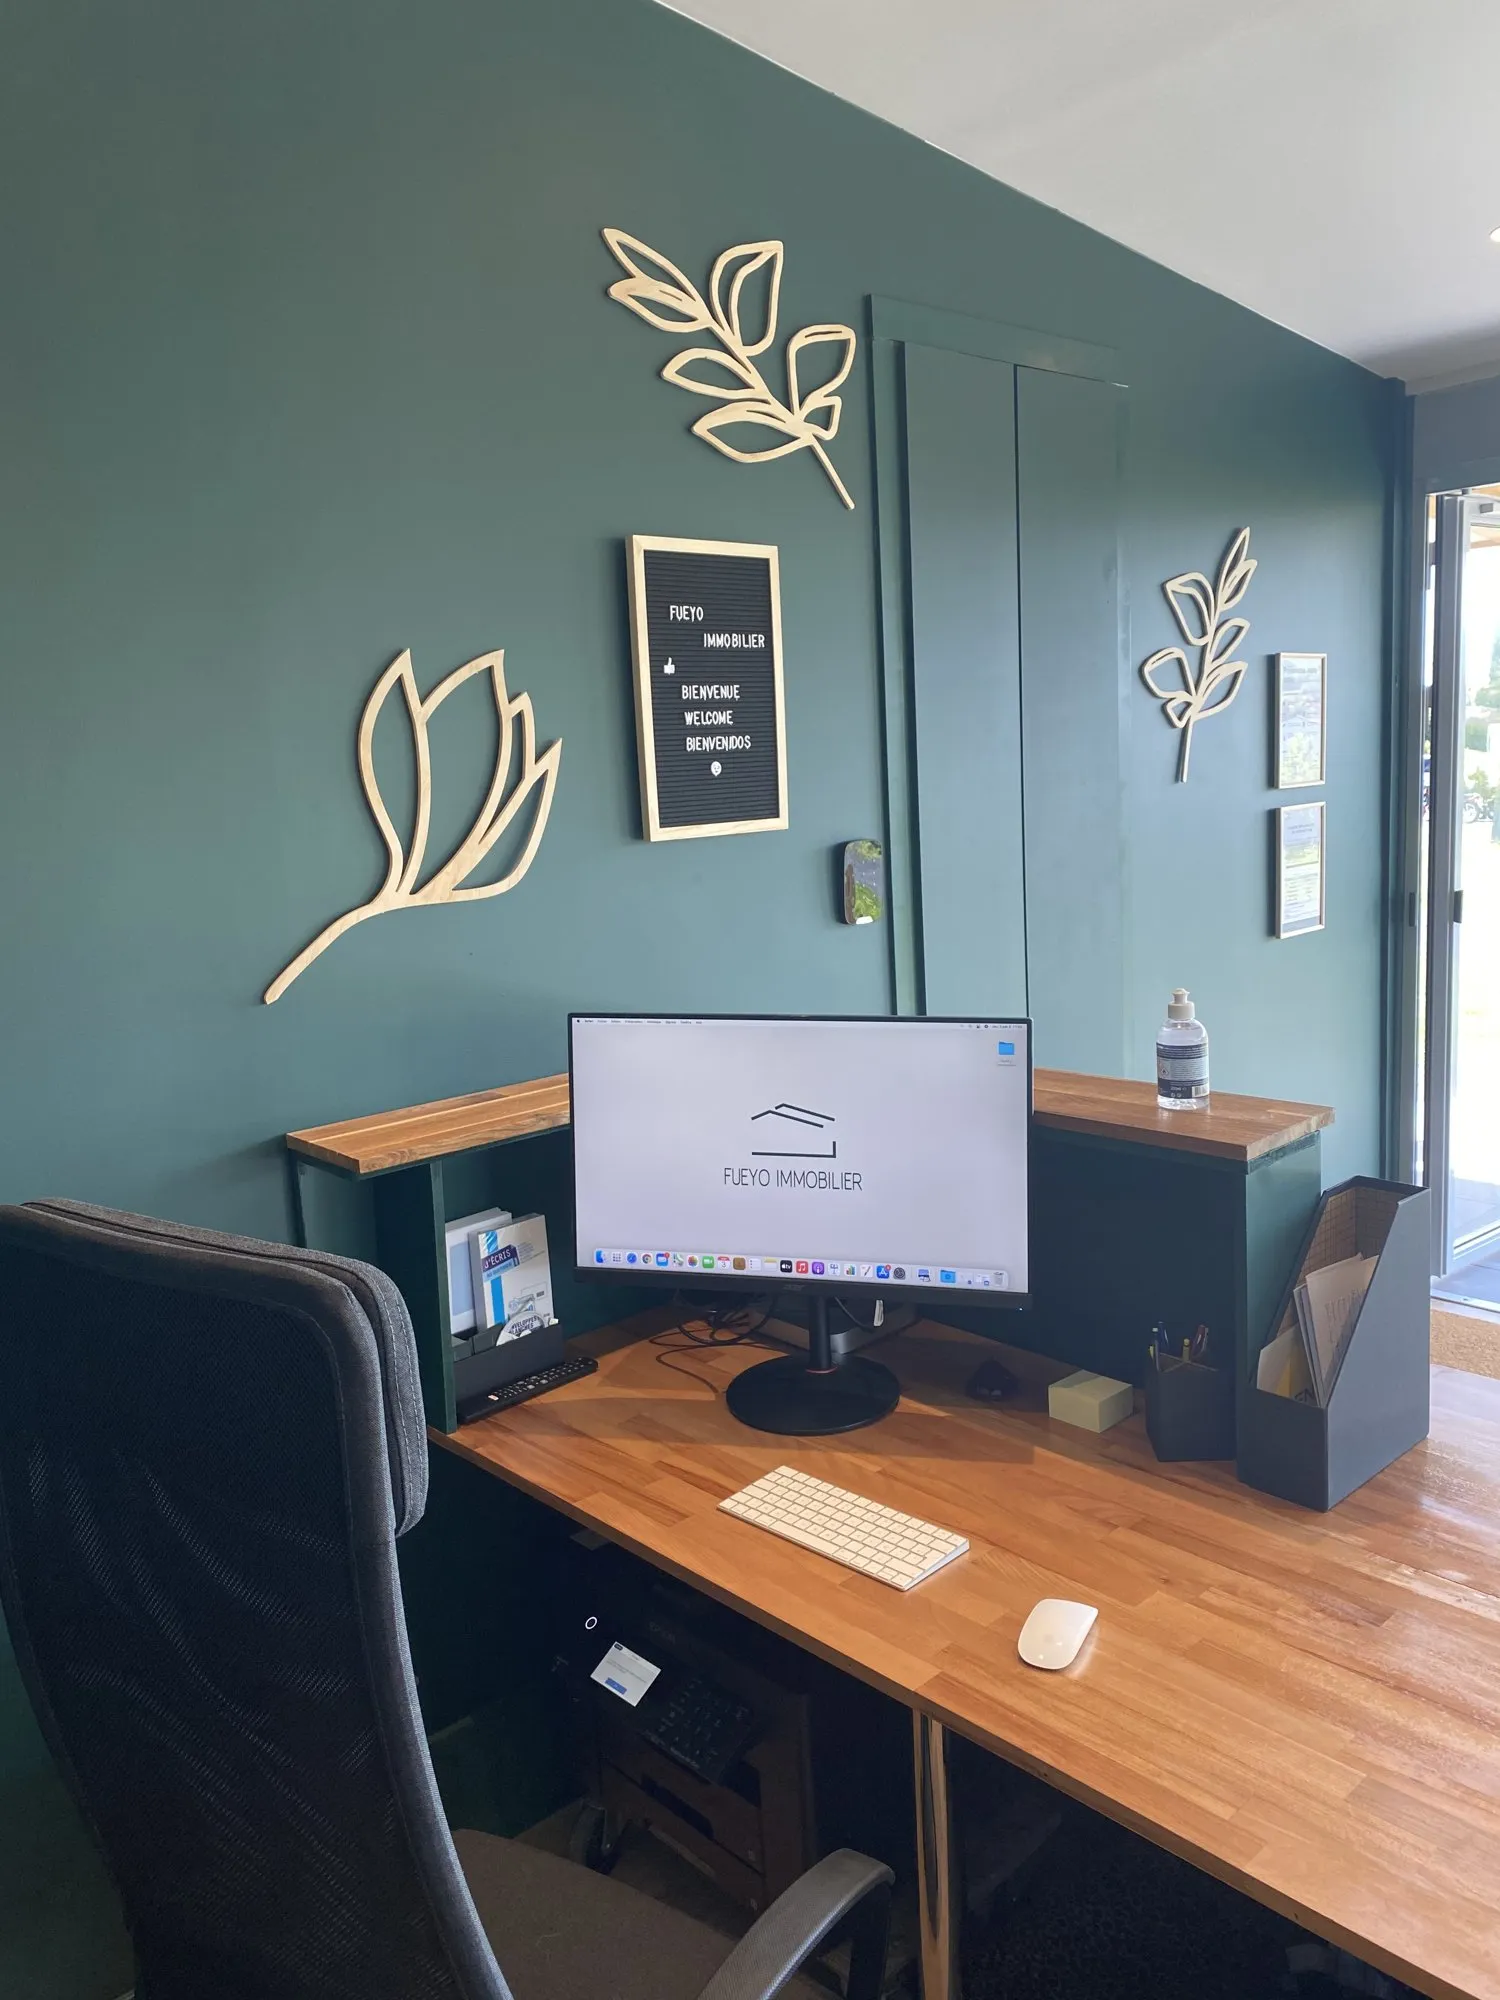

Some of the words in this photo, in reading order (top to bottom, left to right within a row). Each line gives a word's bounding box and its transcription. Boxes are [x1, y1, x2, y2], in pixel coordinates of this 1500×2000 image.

[669, 605, 704, 622] FUEYO
[703, 633, 765, 649] IMMOBILIER
[681, 684, 741, 701] BIENVENUE
[684, 710, 733, 726] WELCOME
[686, 735, 751, 752] BIENVENIDOS
[724, 1167, 770, 1187] FUEYO
[776, 1169, 863, 1191] IMMOBILIER
